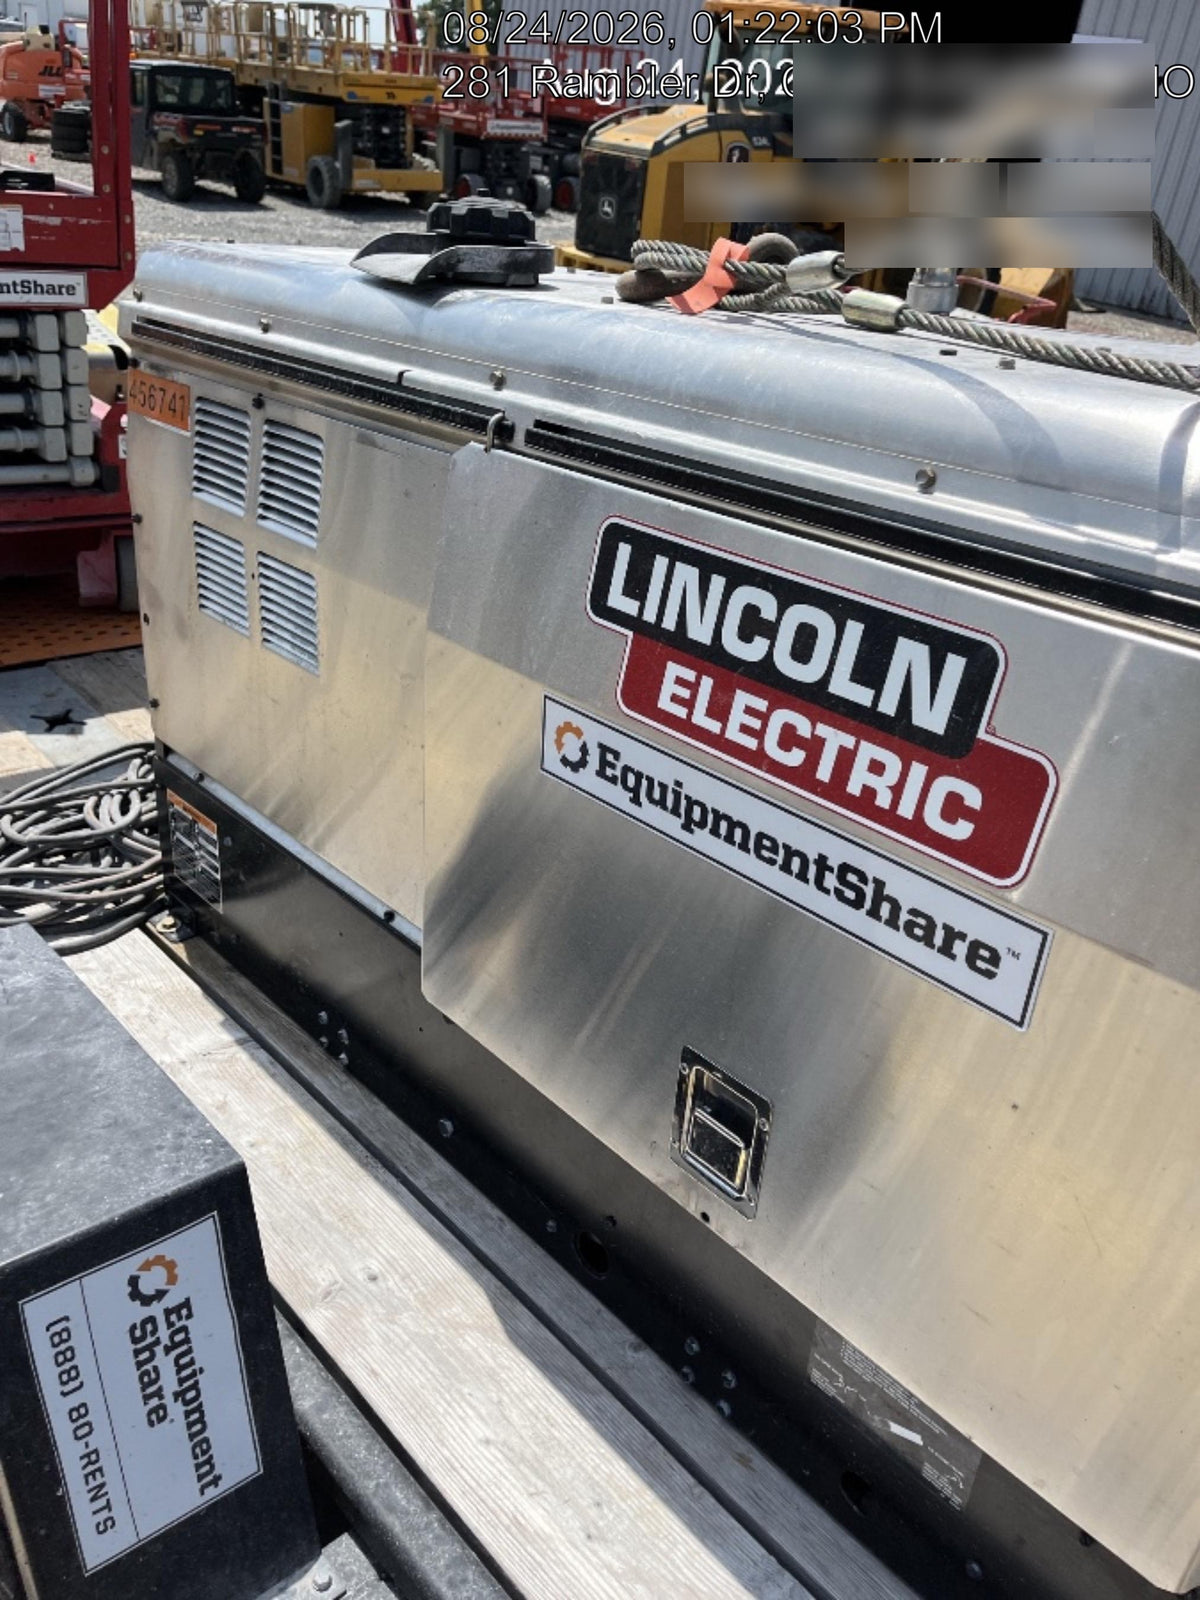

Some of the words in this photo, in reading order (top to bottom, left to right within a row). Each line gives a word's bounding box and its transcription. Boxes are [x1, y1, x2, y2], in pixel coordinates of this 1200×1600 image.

[129, 379, 186, 422] 456741
[605, 541, 968, 737] LINCOLN
[656, 660, 984, 842] ELECTRIC
[595, 741, 1002, 981] EquipmentShare
[45, 1314, 85, 1399] (888)
[68, 1401, 117, 1536] 80-RENTS
[129, 1314, 169, 1429] Share
[163, 1296, 225, 1496] Equipment
